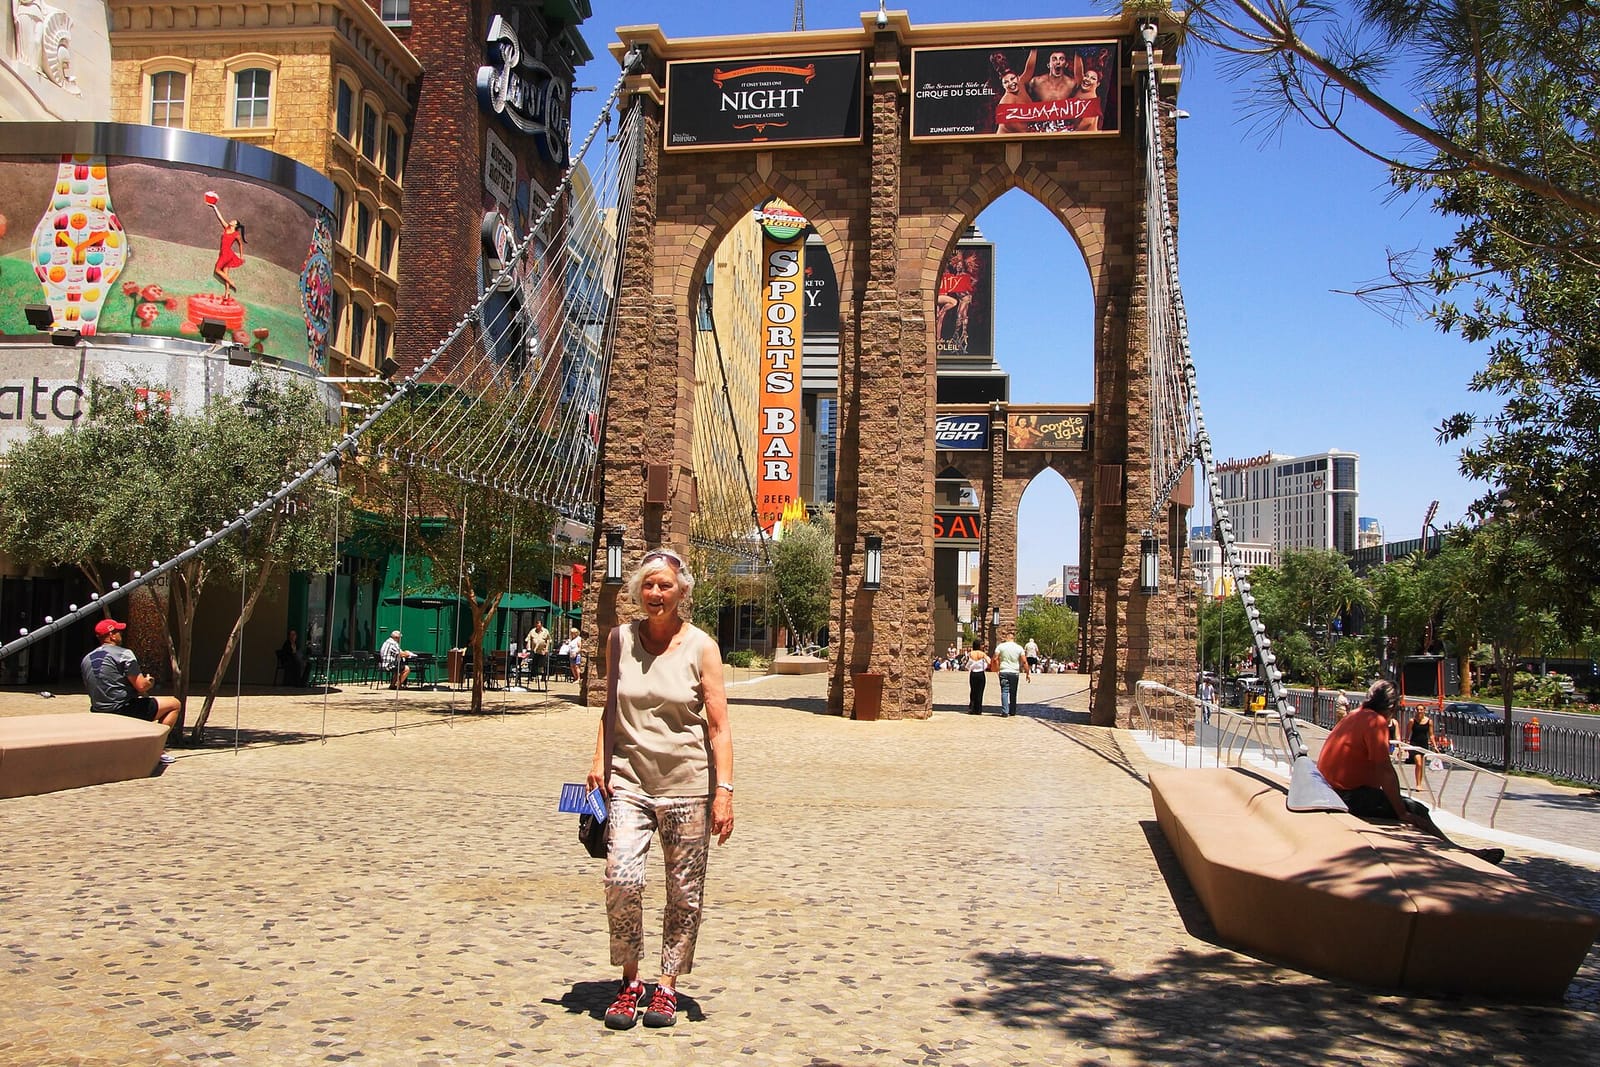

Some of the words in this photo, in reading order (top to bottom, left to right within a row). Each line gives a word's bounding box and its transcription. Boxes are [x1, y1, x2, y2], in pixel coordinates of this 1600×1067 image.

[720, 89, 803, 111] NIGHT
[916, 89, 949, 100] CIRQUE
[951, 89, 964, 97] DU
[965, 88, 996, 97] SOLEIL
[1005, 100, 1092, 120] ZUMANITY
[929, 126, 975, 135] ZUMANITY.COM
[766, 249, 800, 394] SPORTS
[936, 421, 981, 431] BUD
[1039, 416, 1083, 434] coyote
[1053, 425, 1086, 441] ugly
[762, 407, 796, 482] BAR
[936, 431, 984, 441] IGHT
[1216, 450, 1271, 475] hollywood
[764, 494, 791, 504] BEER
